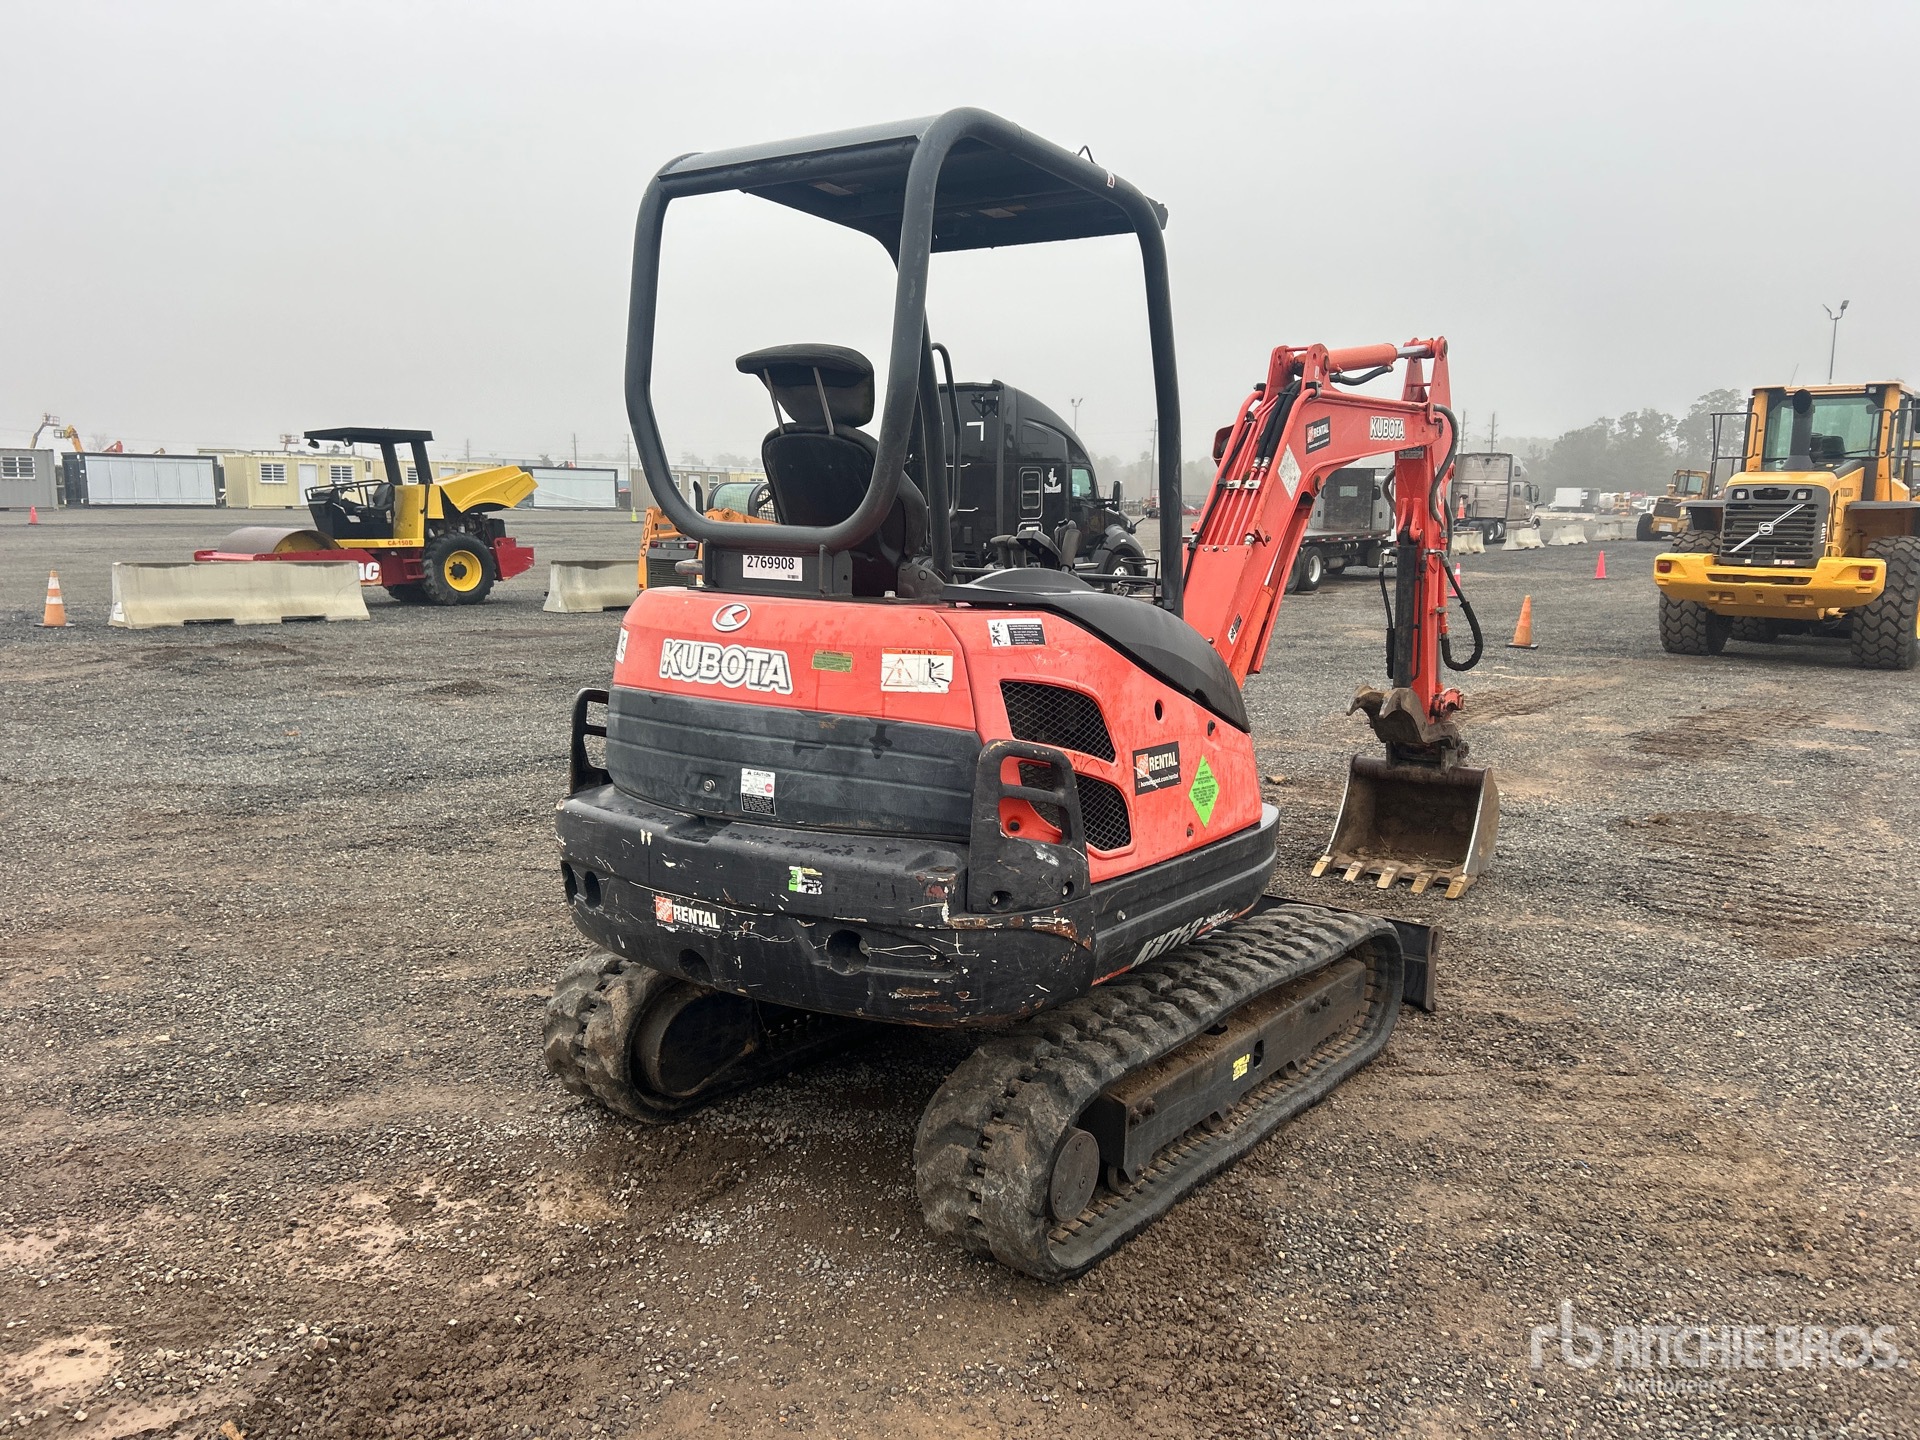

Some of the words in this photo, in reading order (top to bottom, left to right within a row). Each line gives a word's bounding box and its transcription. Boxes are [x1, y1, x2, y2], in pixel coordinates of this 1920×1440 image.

[1369, 416, 1405, 440] KUBOTA
[746, 555, 795, 570] 2769908
[660, 639, 793, 694] KUBOTA
[1148, 751, 1178, 772] RENTAL
[673, 904, 720, 929] RENTAL
